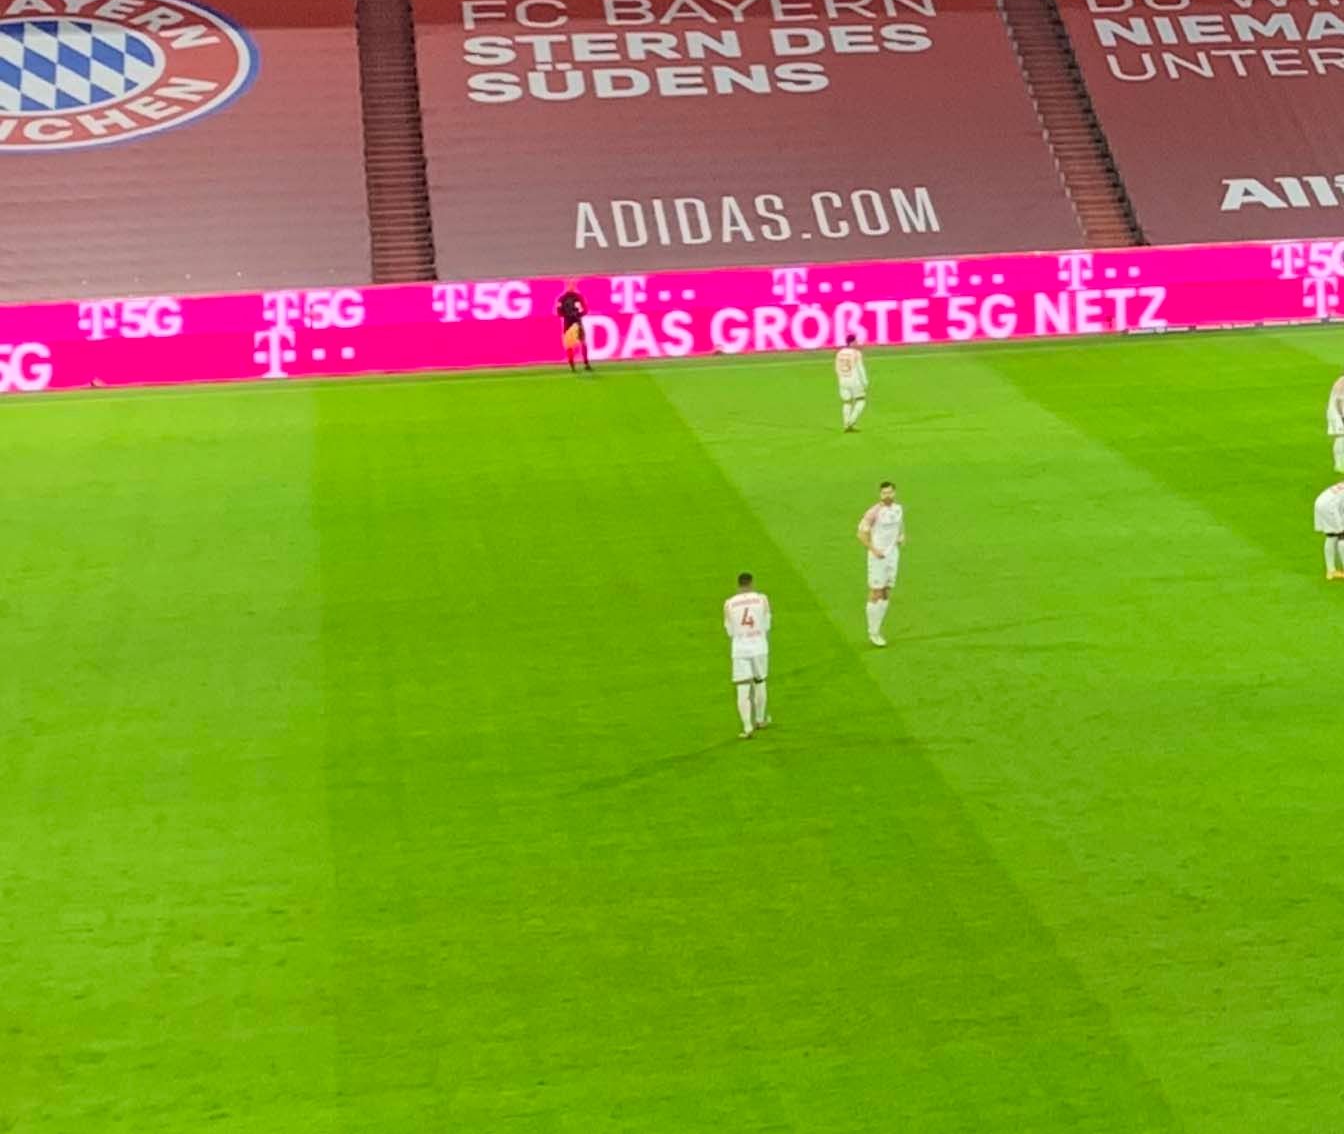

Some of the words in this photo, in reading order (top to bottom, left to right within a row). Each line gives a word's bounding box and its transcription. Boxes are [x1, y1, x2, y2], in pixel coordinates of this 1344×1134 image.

[463, 29, 742, 66] STERN
[770, 22, 933, 56] DES
[0, 76, 220, 142] CHEN
[466, 62, 831, 103] SÜDENS
[575, 187, 941, 250] ADIDAS.COM
[584, 312, 694, 360] DAS
[946, 293, 1017, 337] 5G
[1034, 286, 1168, 334] NETZ
[740, 607, 754, 628] 4
